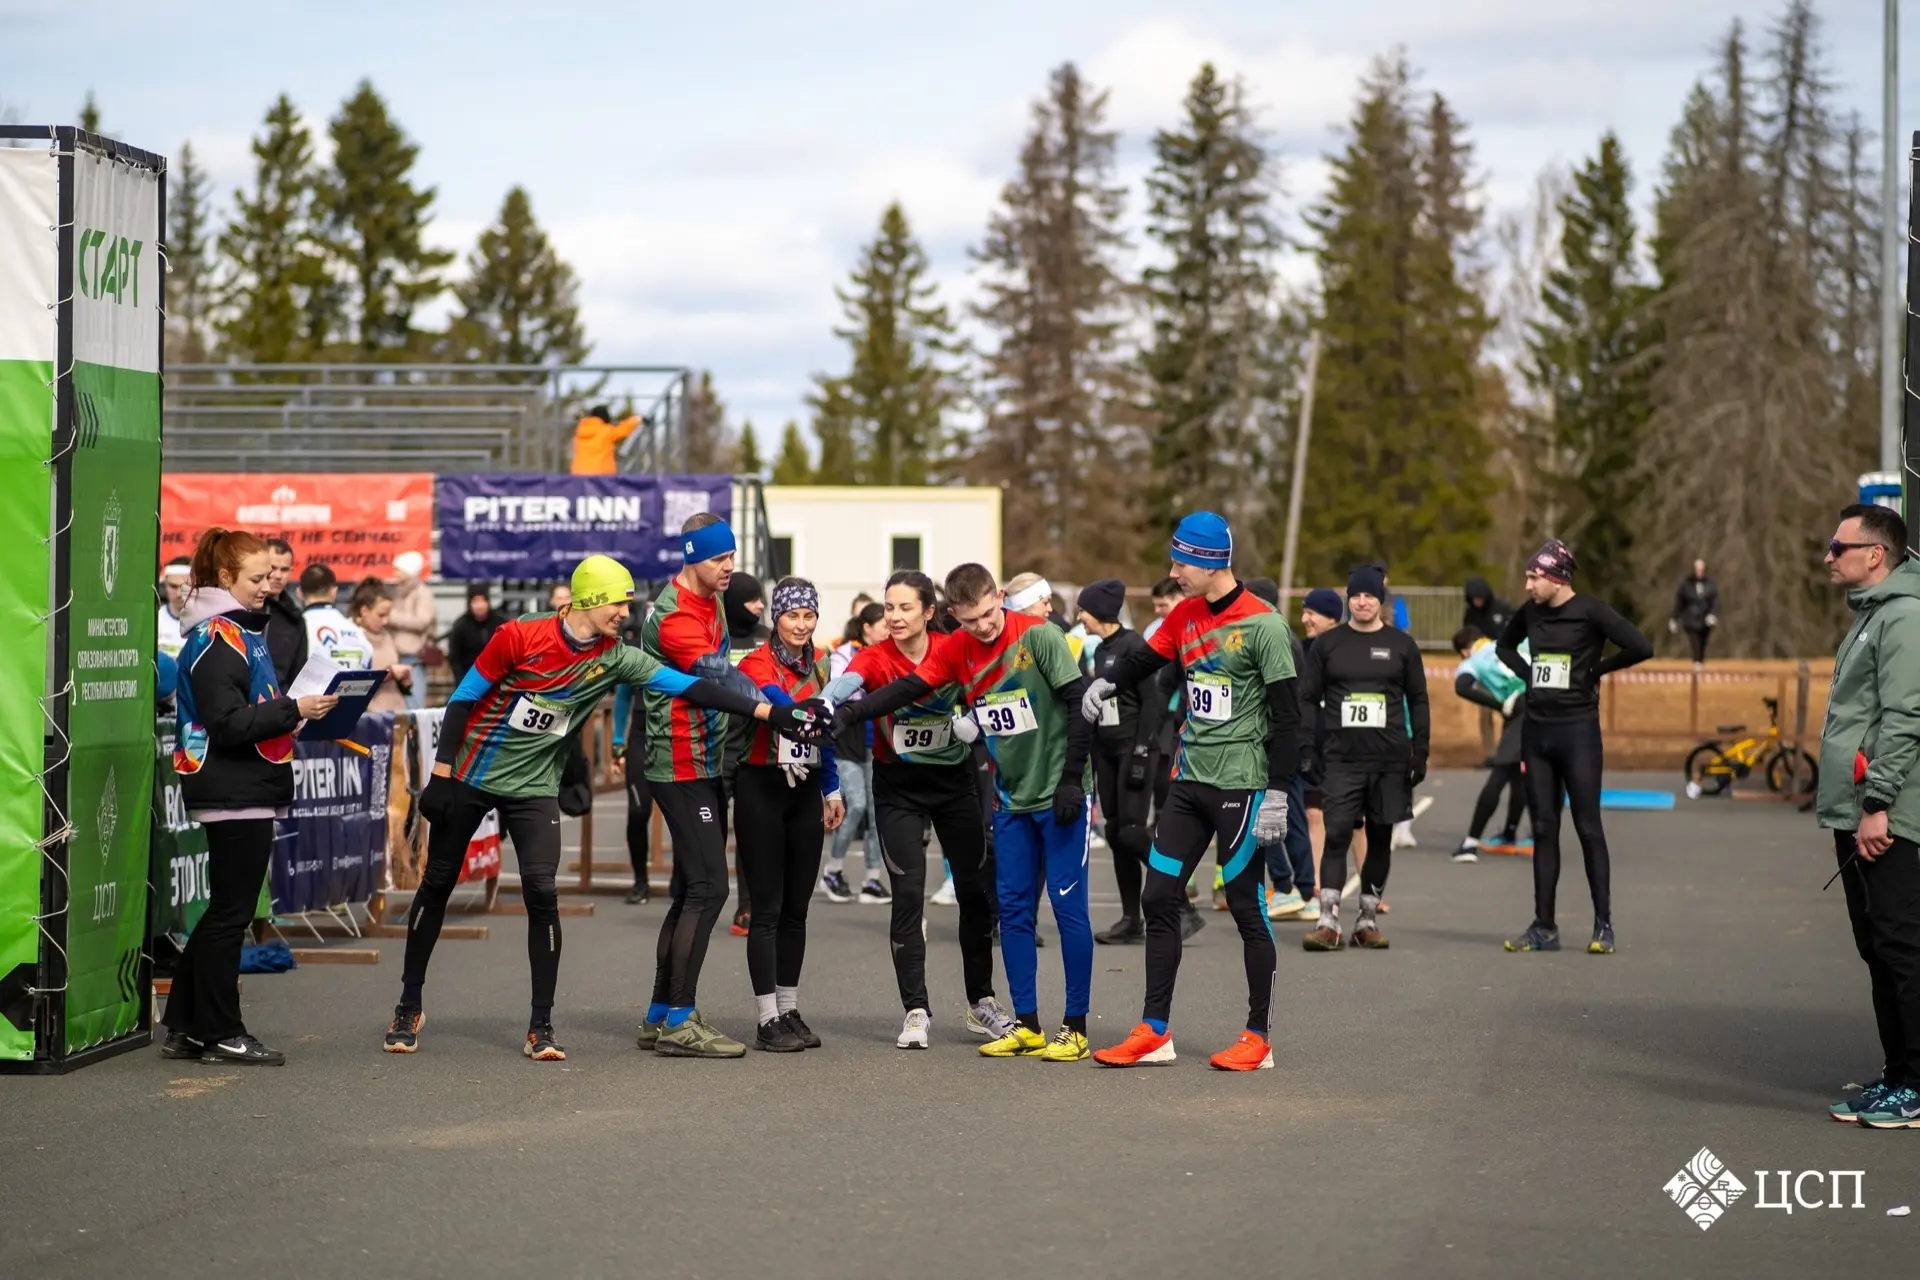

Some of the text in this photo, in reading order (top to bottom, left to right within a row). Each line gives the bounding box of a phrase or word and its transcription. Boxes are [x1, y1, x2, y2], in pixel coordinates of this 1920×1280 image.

[78, 227, 143, 308] СТАРТ
[464, 496, 641, 522] PITER INN
[580, 592, 609, 608] RUS
[87, 617, 128, 637] МИНИСТЕРСТВО
[77, 650, 113, 669] ОБРАЗОВАНИЯ
[119, 648, 139, 668] СПОРТА
[1536, 665, 1551, 683] 78
[1192, 684, 1229, 713] 39 5
[522, 707, 555, 730] 39
[987, 696, 1028, 732] 39 4
[1349, 705, 1368, 722] 78
[904, 720, 950, 748] 39 2
[790, 740, 812, 759] 39
[291, 758, 337, 800] PITER
[92, 881, 117, 925] ЦСП
